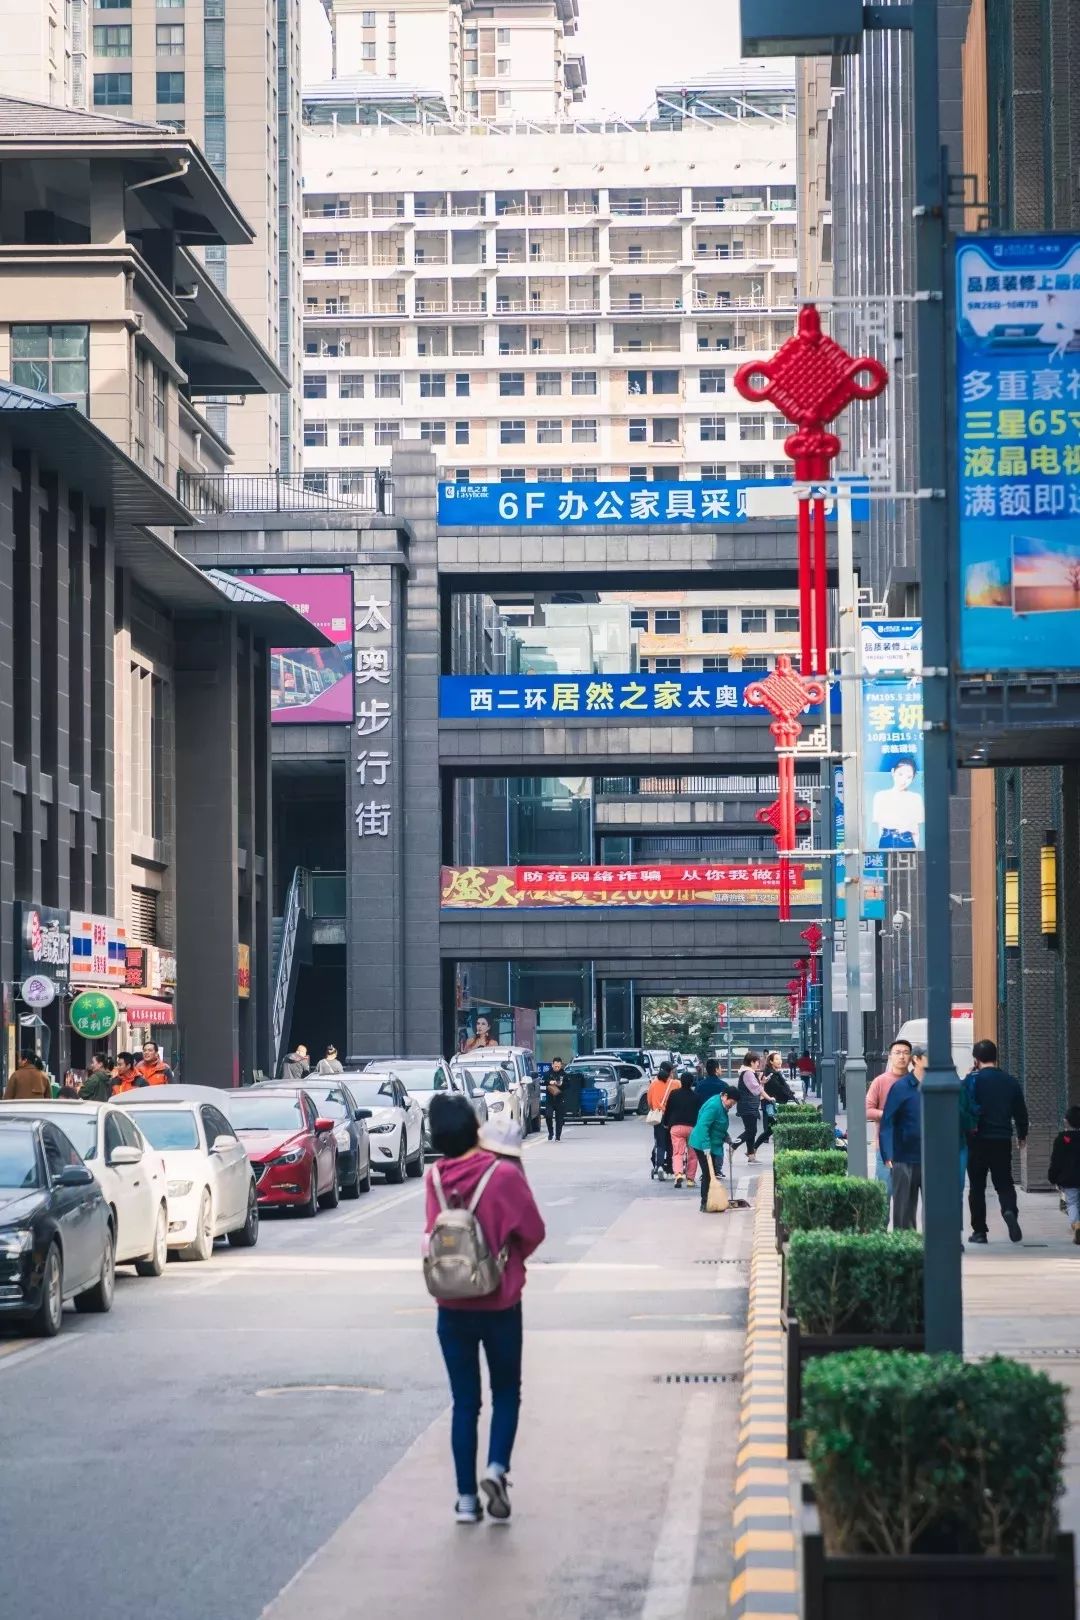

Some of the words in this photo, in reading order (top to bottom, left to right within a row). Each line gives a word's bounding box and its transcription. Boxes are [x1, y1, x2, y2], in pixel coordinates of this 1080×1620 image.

[498, 491, 545, 520] 6F
[354, 594, 392, 837] 太奥步行街
[523, 869, 662, 883] 防范网络诈骗
[77, 1015, 112, 1031] 便利店
